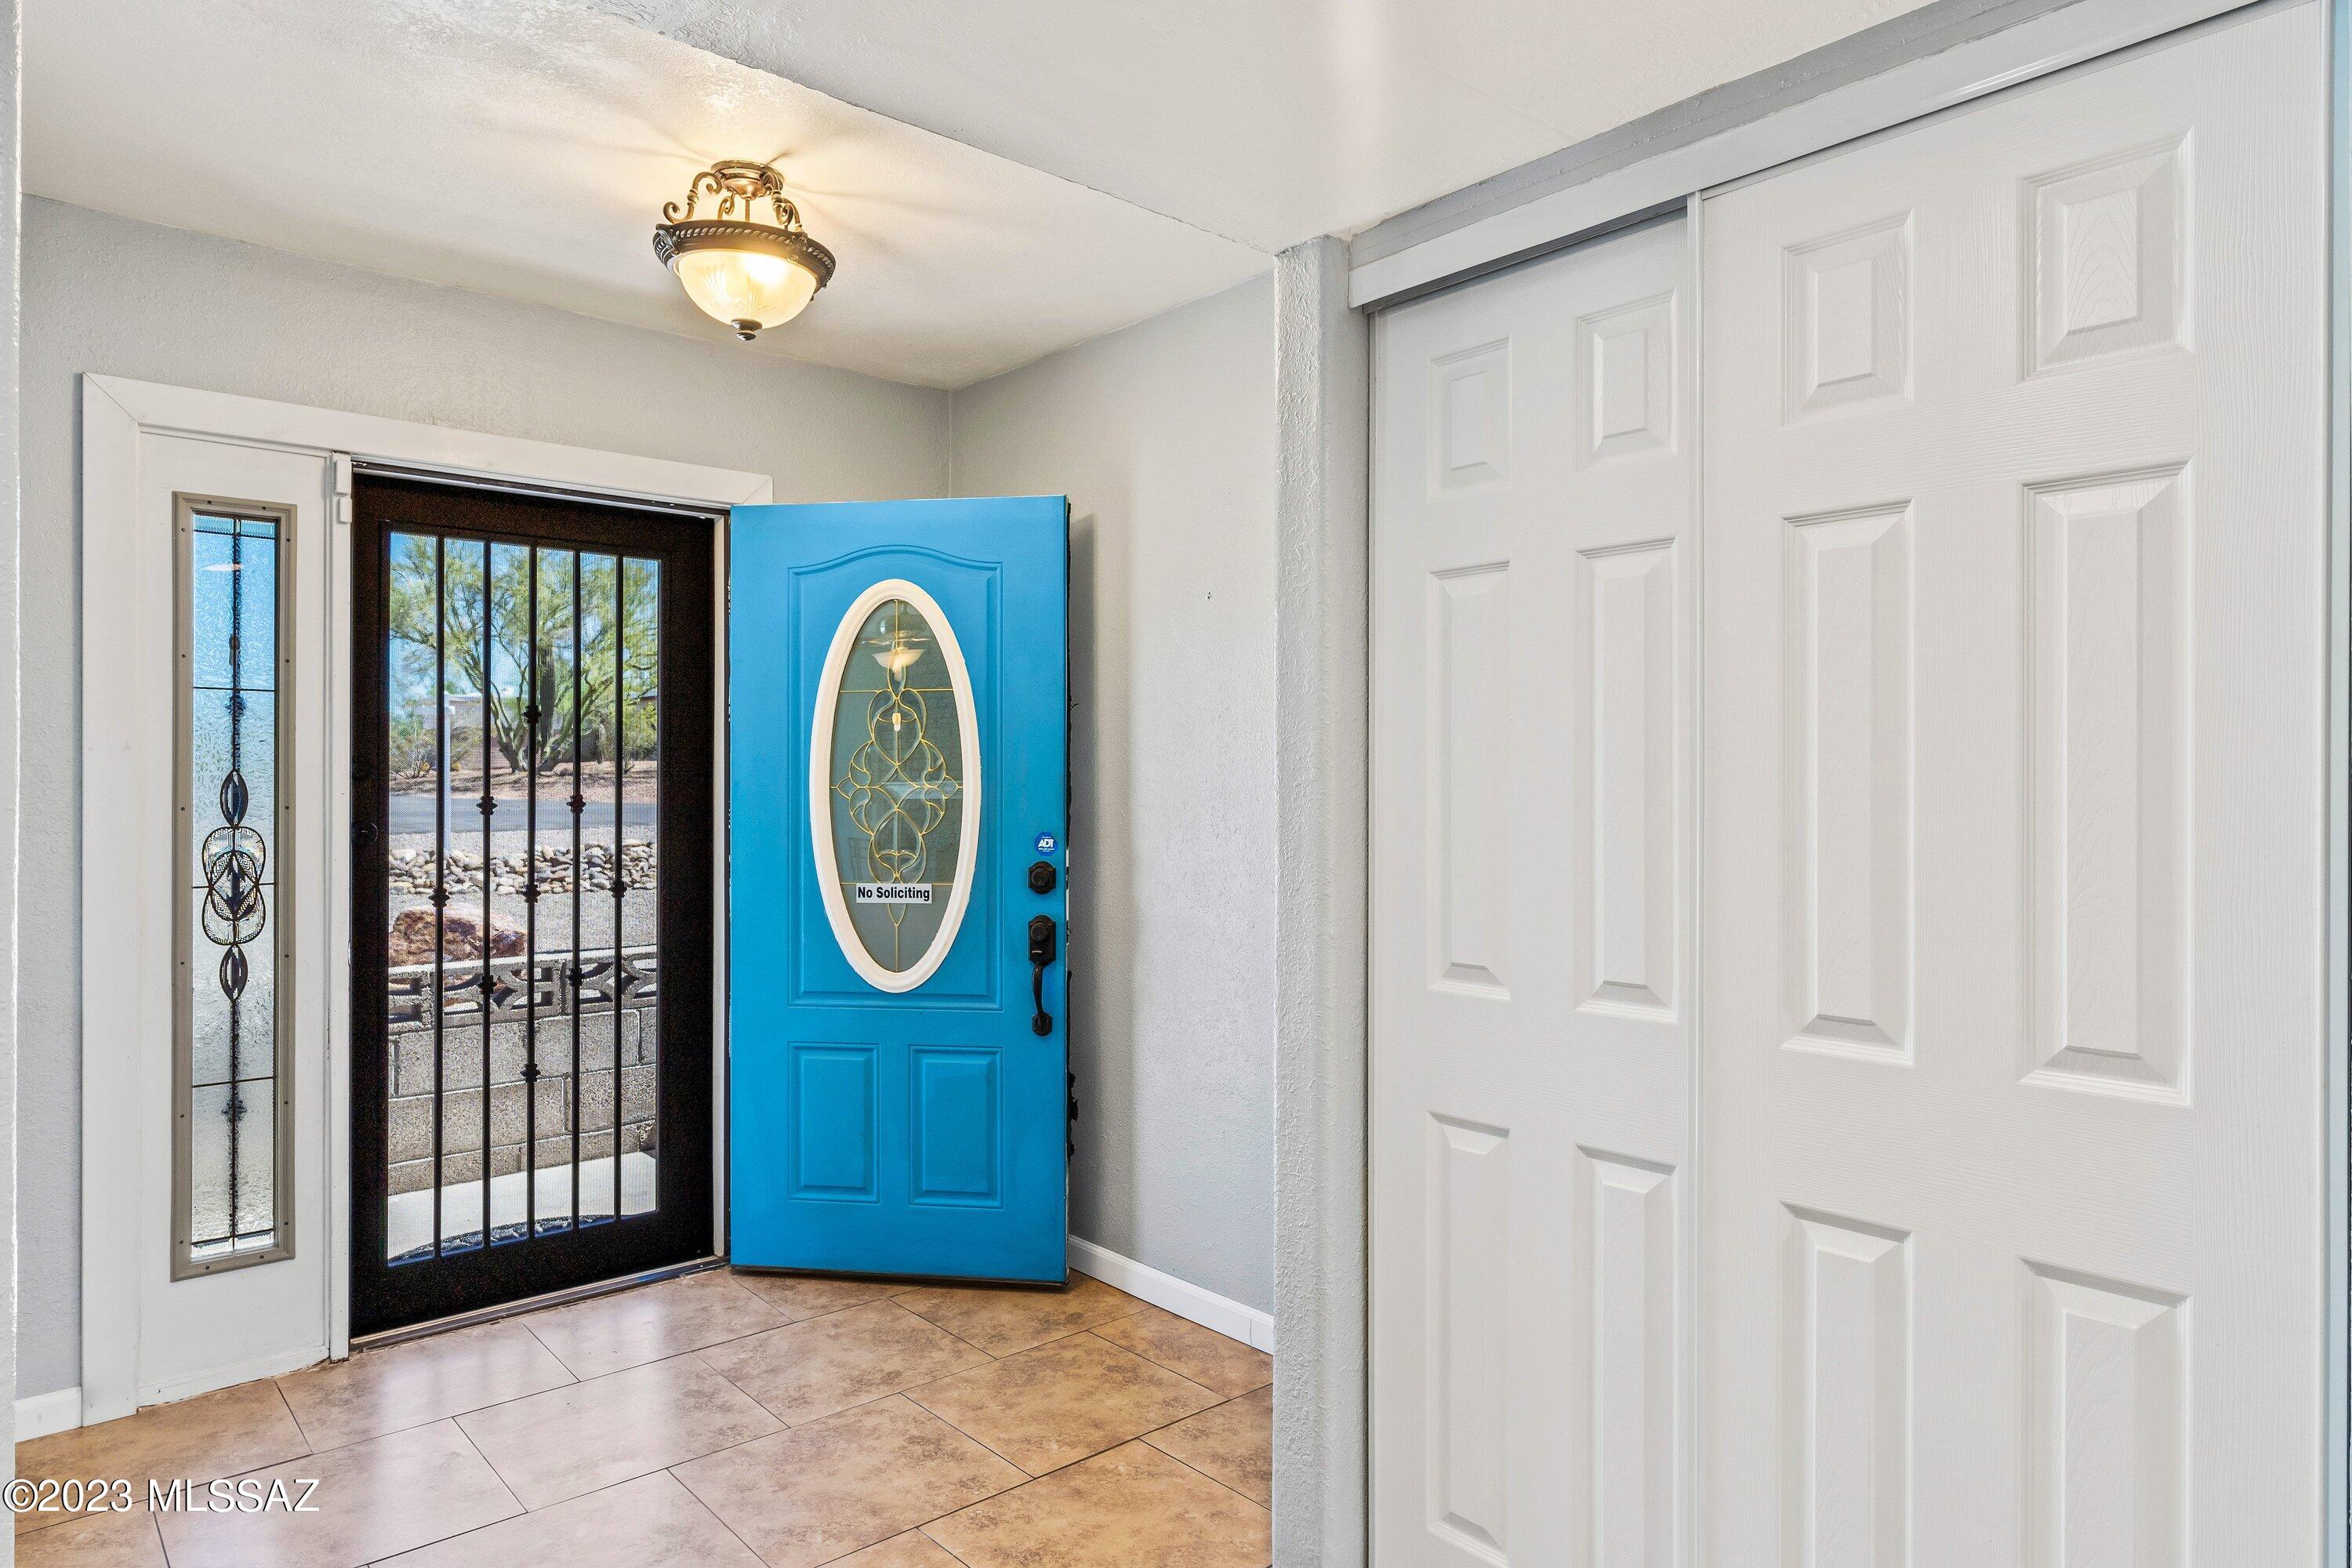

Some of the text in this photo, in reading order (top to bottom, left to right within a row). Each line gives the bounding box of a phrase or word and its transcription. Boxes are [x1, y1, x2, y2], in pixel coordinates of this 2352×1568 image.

[1038, 839, 1054, 848] ADT
[858, 887, 930, 902] No Soliciting
